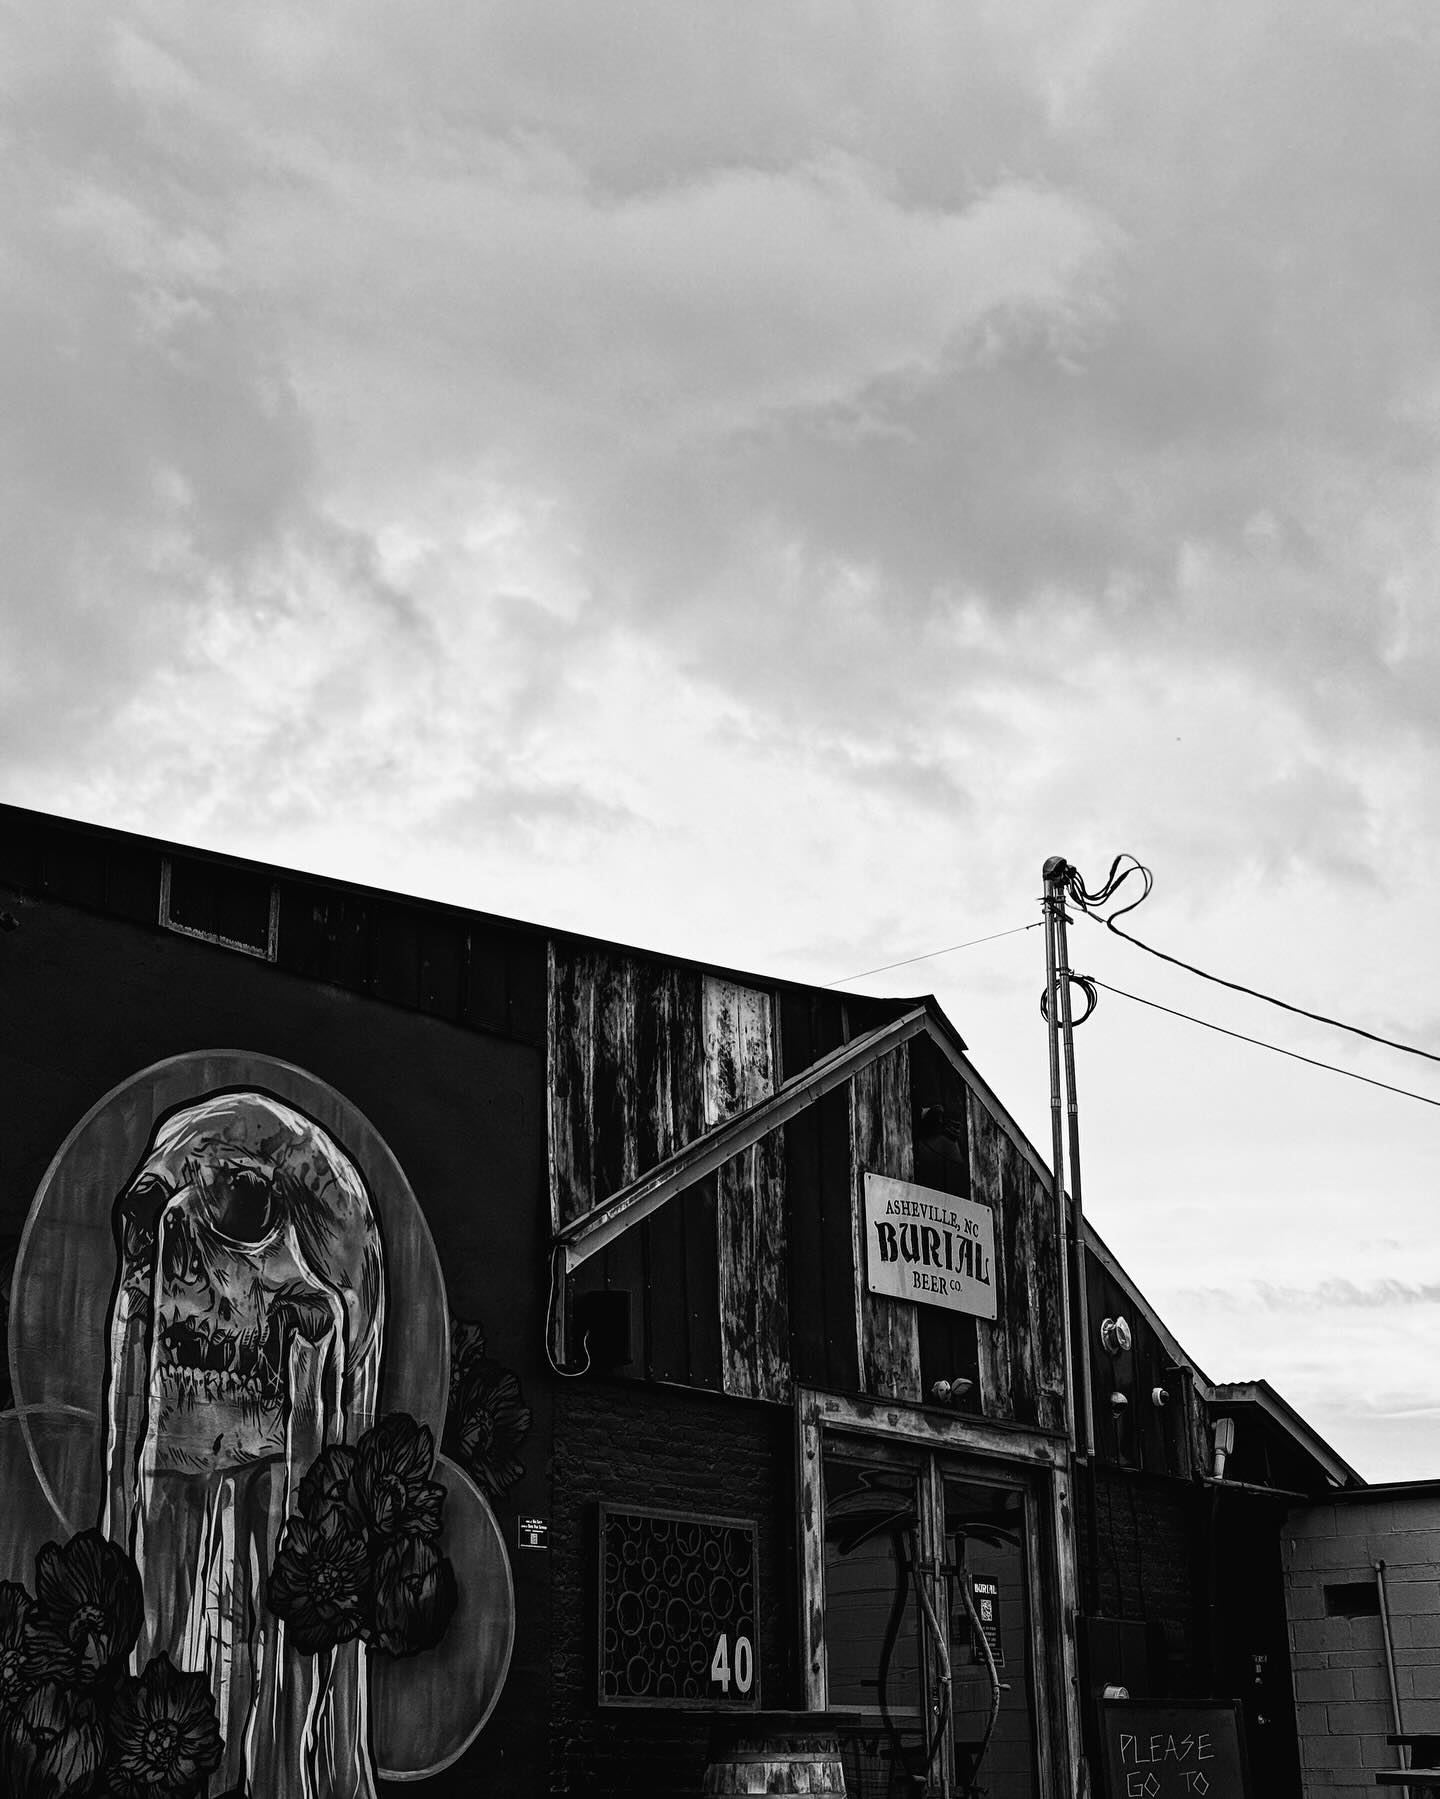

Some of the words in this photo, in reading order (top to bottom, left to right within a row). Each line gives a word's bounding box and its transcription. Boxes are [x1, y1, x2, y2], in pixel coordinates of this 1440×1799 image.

[885, 1200, 961, 1231] ASHEVILLE,
[964, 1218, 979, 1238] NC
[874, 1221, 990, 1286] BURIAL
[912, 1271, 949, 1296] BEER
[711, 1634, 753, 1693] 40
[1119, 1733, 1216, 1764] PLEASE
[1126, 1771, 1161, 1798] GO
[1177, 1770, 1211, 1796] TO
